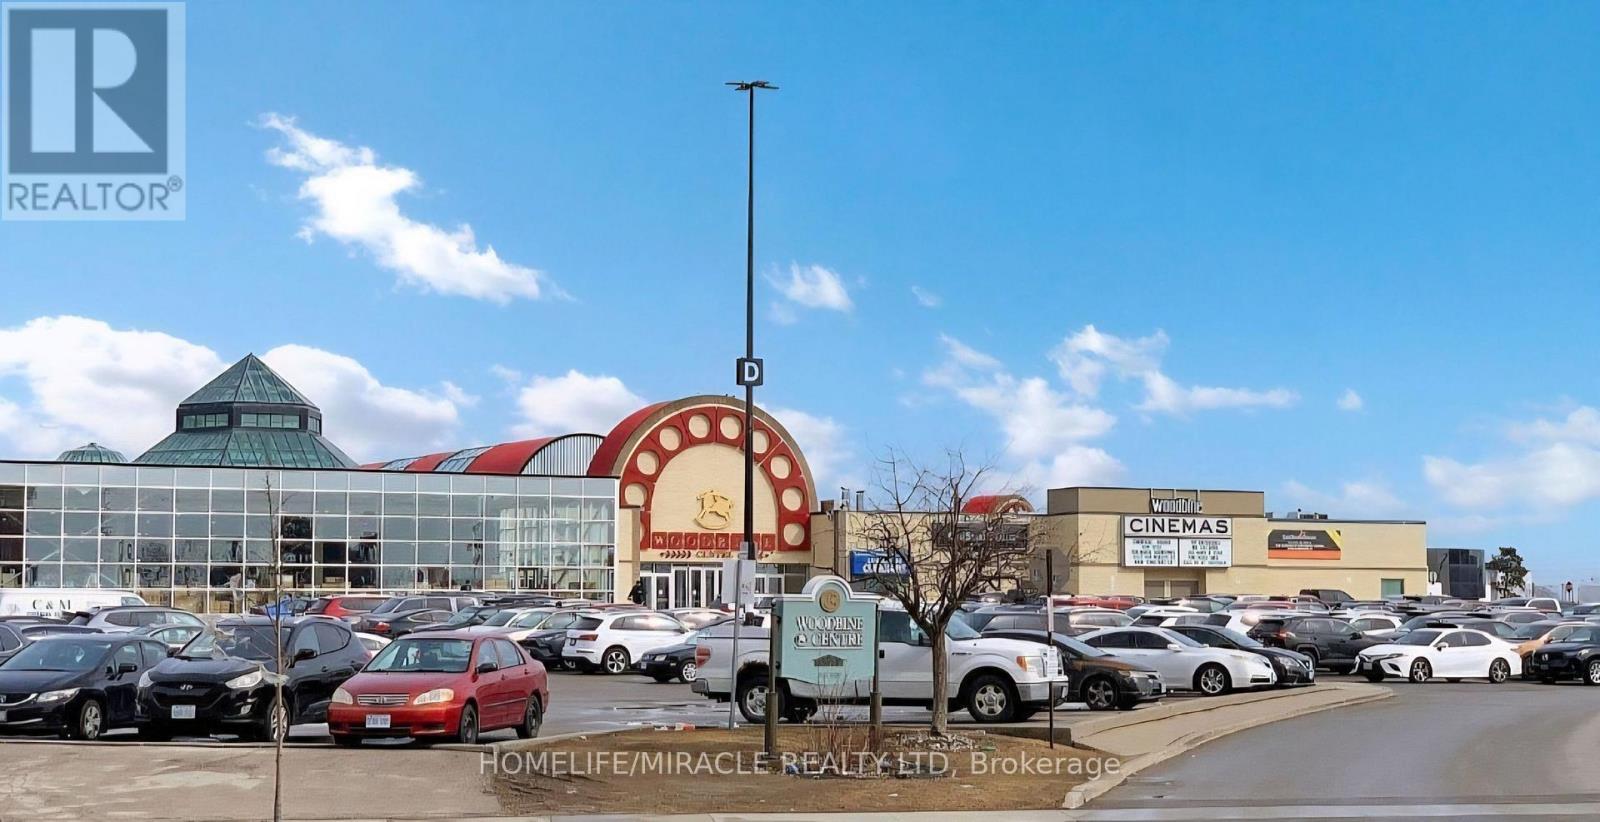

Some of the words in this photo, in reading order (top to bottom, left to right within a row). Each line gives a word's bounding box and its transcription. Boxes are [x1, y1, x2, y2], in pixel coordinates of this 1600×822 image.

[744, 361, 759, 382] D
[1129, 518, 1229, 534] CINEMAS
[795, 615, 864, 631] WOODBINE
[811, 631, 864, 647] CENTRE
